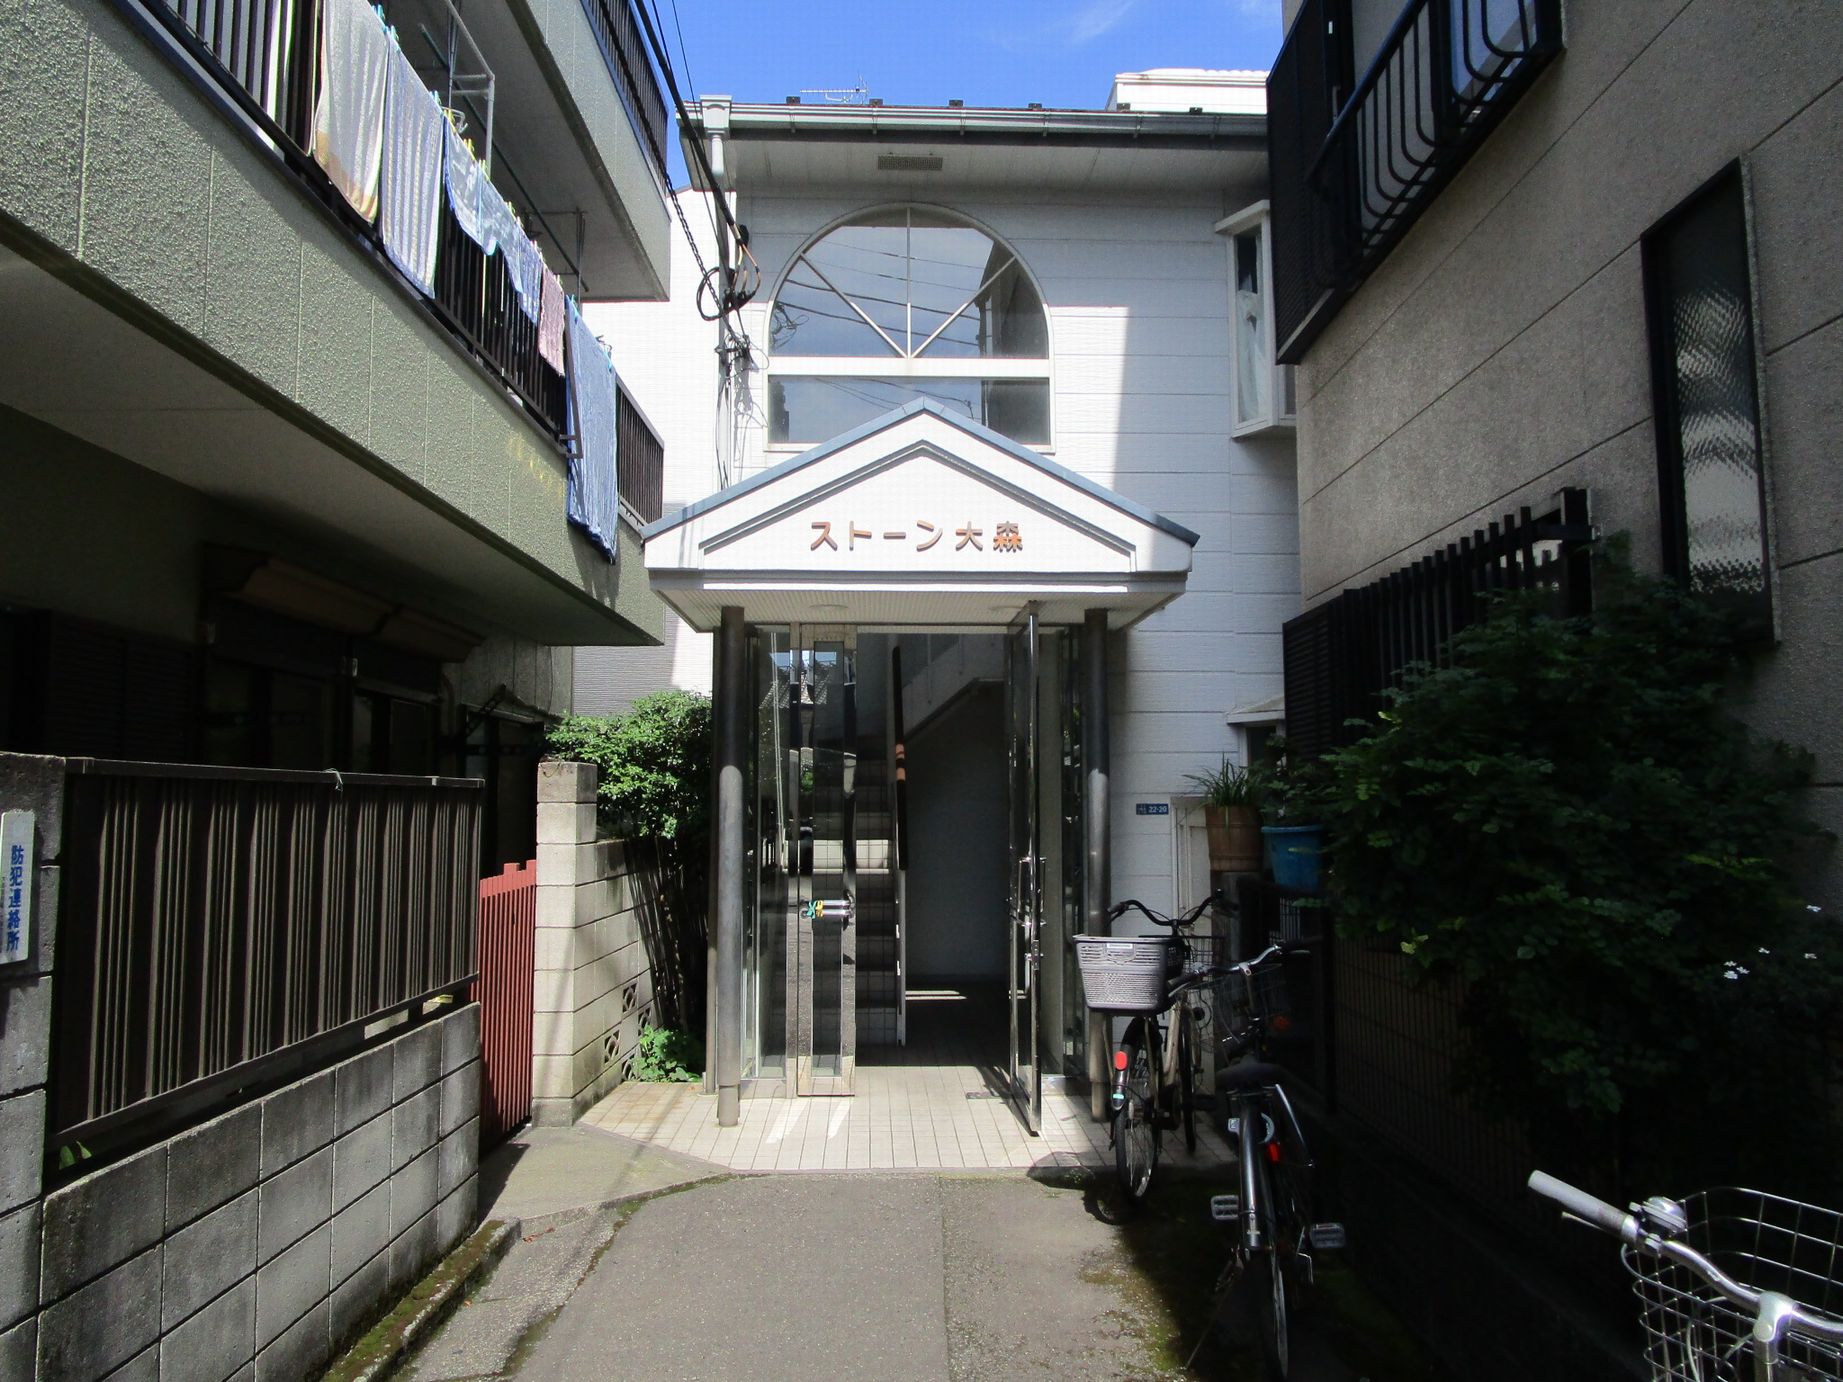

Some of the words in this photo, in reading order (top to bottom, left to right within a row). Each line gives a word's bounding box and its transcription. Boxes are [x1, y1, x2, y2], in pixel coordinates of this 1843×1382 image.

[810, 520, 1023, 552] ストーン大森
[1149, 805, 1168, 813] 22-20
[6, 845, 24, 951] 防犯連絡所
